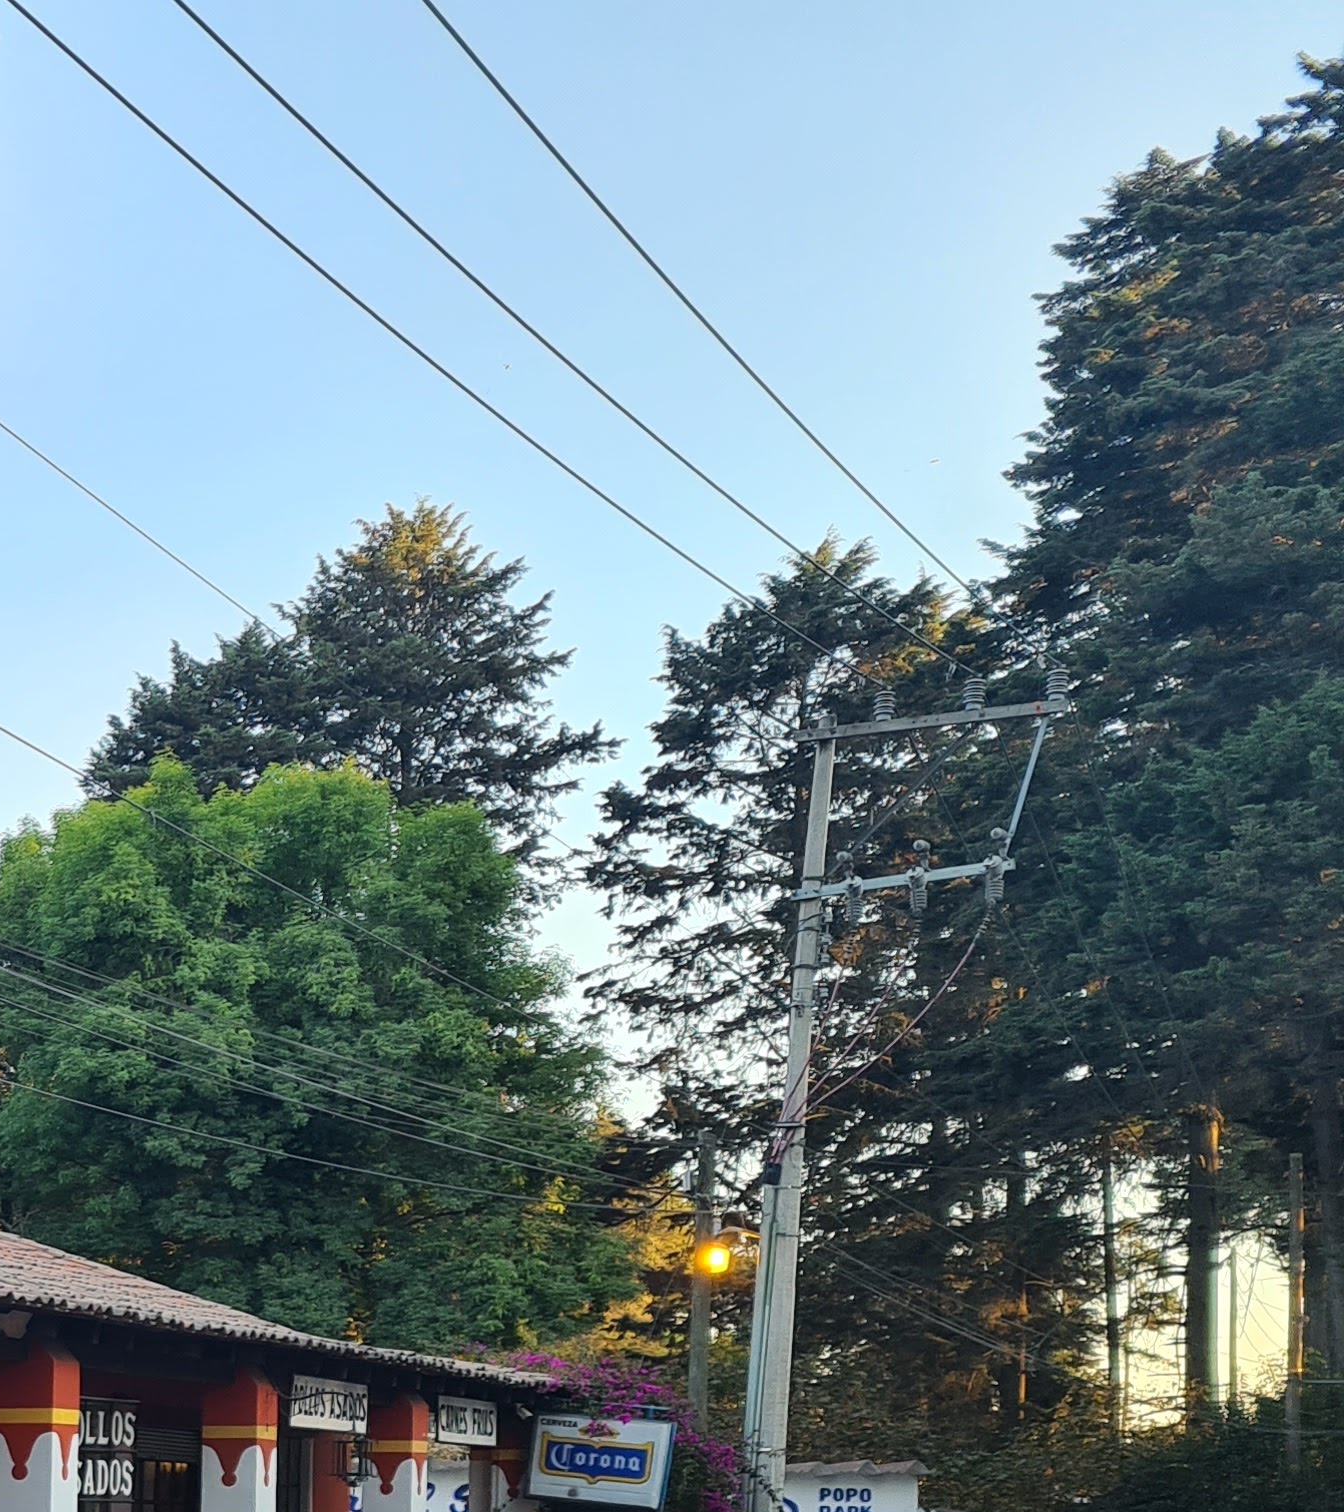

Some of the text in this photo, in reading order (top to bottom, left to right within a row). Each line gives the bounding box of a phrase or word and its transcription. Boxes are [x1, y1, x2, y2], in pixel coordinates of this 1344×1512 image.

[540, 1418, 578, 1428] CERVEZA
[550, 1444, 641, 1471] Corona
[819, 1488, 872, 1502] POPO
